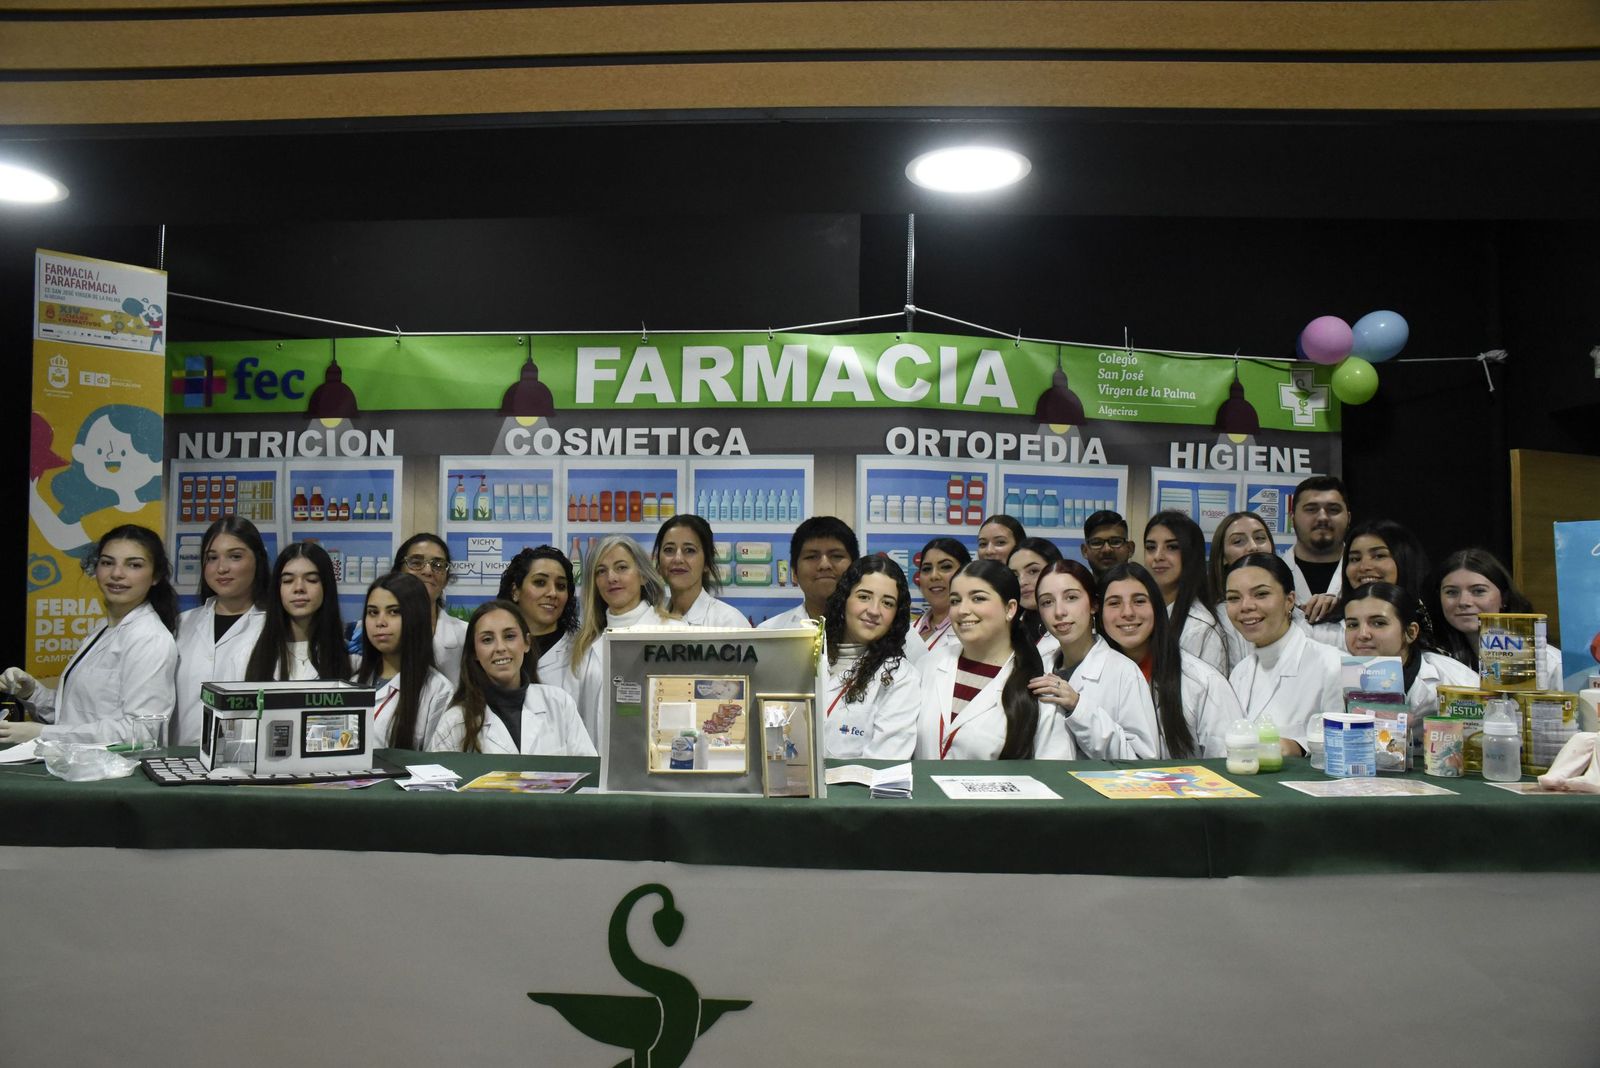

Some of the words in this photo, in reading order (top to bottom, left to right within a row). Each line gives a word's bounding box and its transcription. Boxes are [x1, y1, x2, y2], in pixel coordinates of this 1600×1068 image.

[45, 262, 93, 280] FARMACIA
[45, 275, 117, 294] PARAFARMACIA
[1098, 352, 1138, 366] Colegio
[233, 357, 305, 401] fec
[575, 343, 1018, 409] FARMACIA
[1098, 369, 1119, 380] San
[1121, 370, 1144, 382] José
[1098, 384, 1133, 398] Virgen
[1136, 385, 1149, 396] de
[1151, 386, 1161, 397] la
[1163, 388, 1196, 400] Palma
[1098, 406, 1138, 417] Algeciras
[178, 429, 395, 459] NUTRICION
[505, 427, 751, 456] COSMETICA
[886, 427, 1108, 464] ORTOPEDIA
[1170, 442, 1312, 474] HIGIENE
[36, 598, 103, 617] FERIA
[36, 619, 65, 636] DE
[1480, 636, 1523, 650] NAN
[644, 643, 759, 663] FARMACIA
[1492, 662, 1500, 679] 1
[305, 693, 345, 706] LUNA
[1447, 705, 1487, 716] NESTUM
[851, 727, 865, 736] fec
